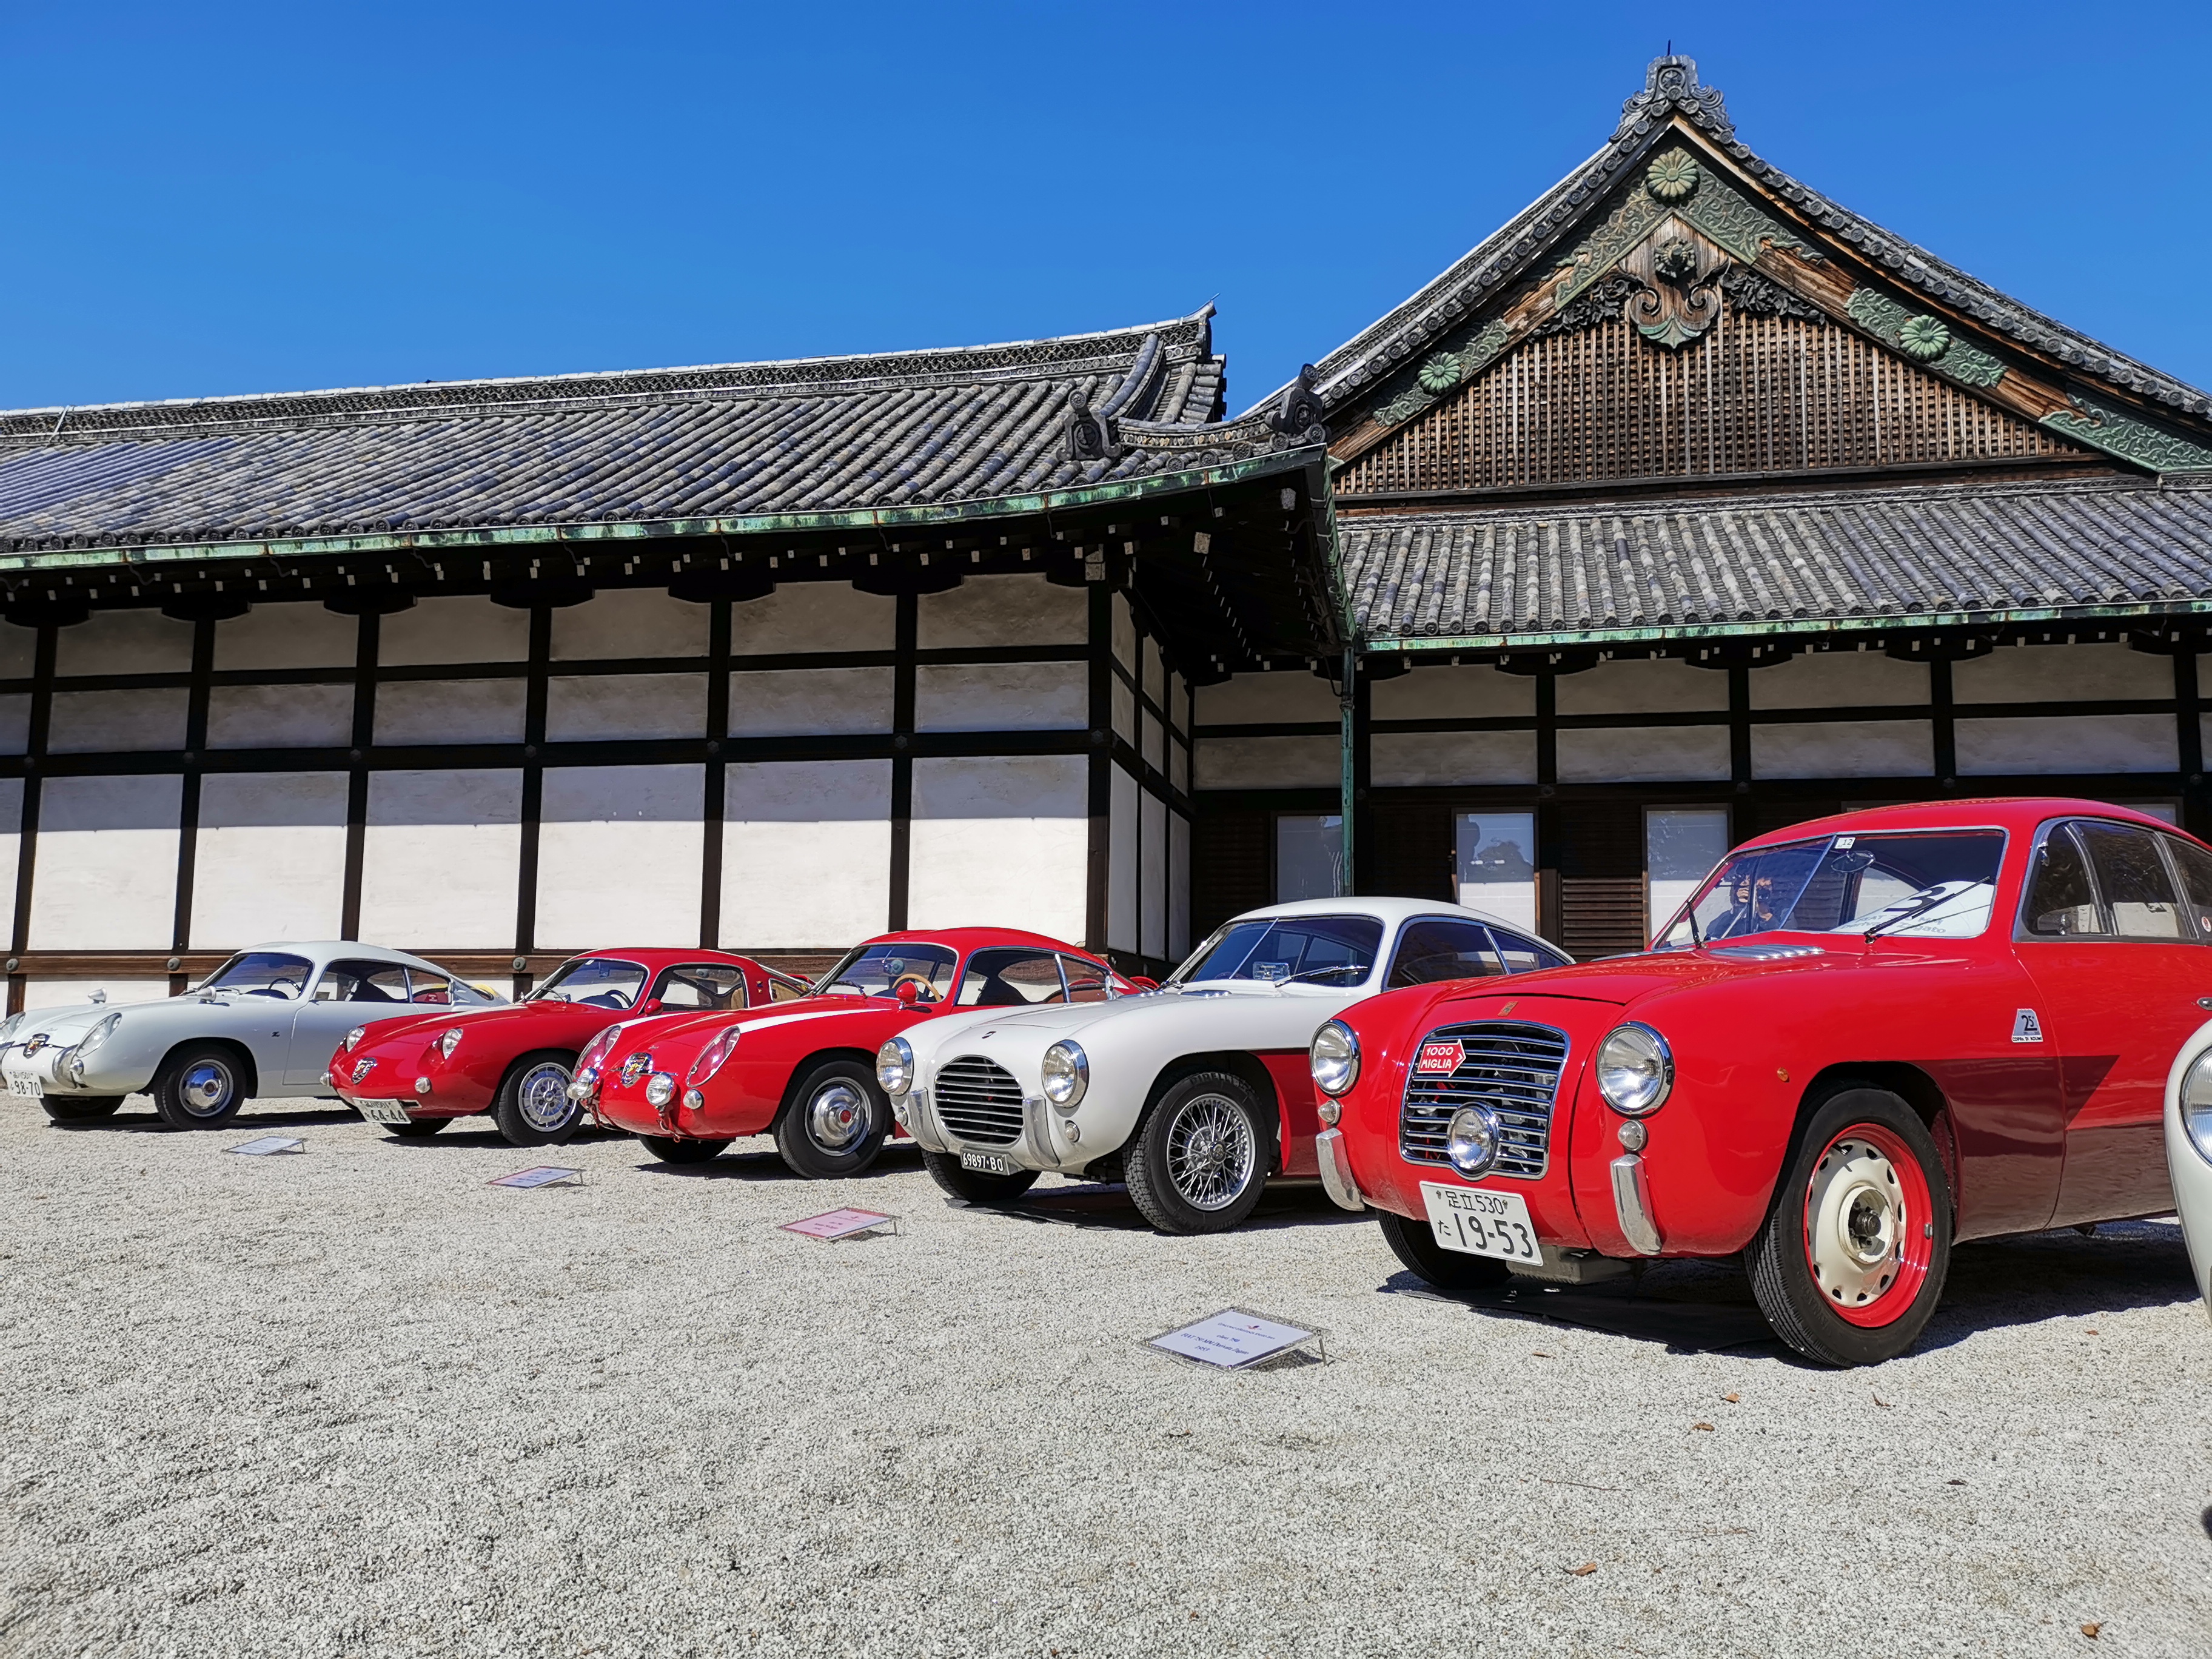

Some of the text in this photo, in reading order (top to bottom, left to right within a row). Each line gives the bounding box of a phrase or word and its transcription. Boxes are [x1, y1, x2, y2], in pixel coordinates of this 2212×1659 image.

[1426, 1047, 1454, 1056] 1000
[1420, 1058, 1452, 1069] MIGLIA
[1437, 1213, 1533, 1258] た 19-53
